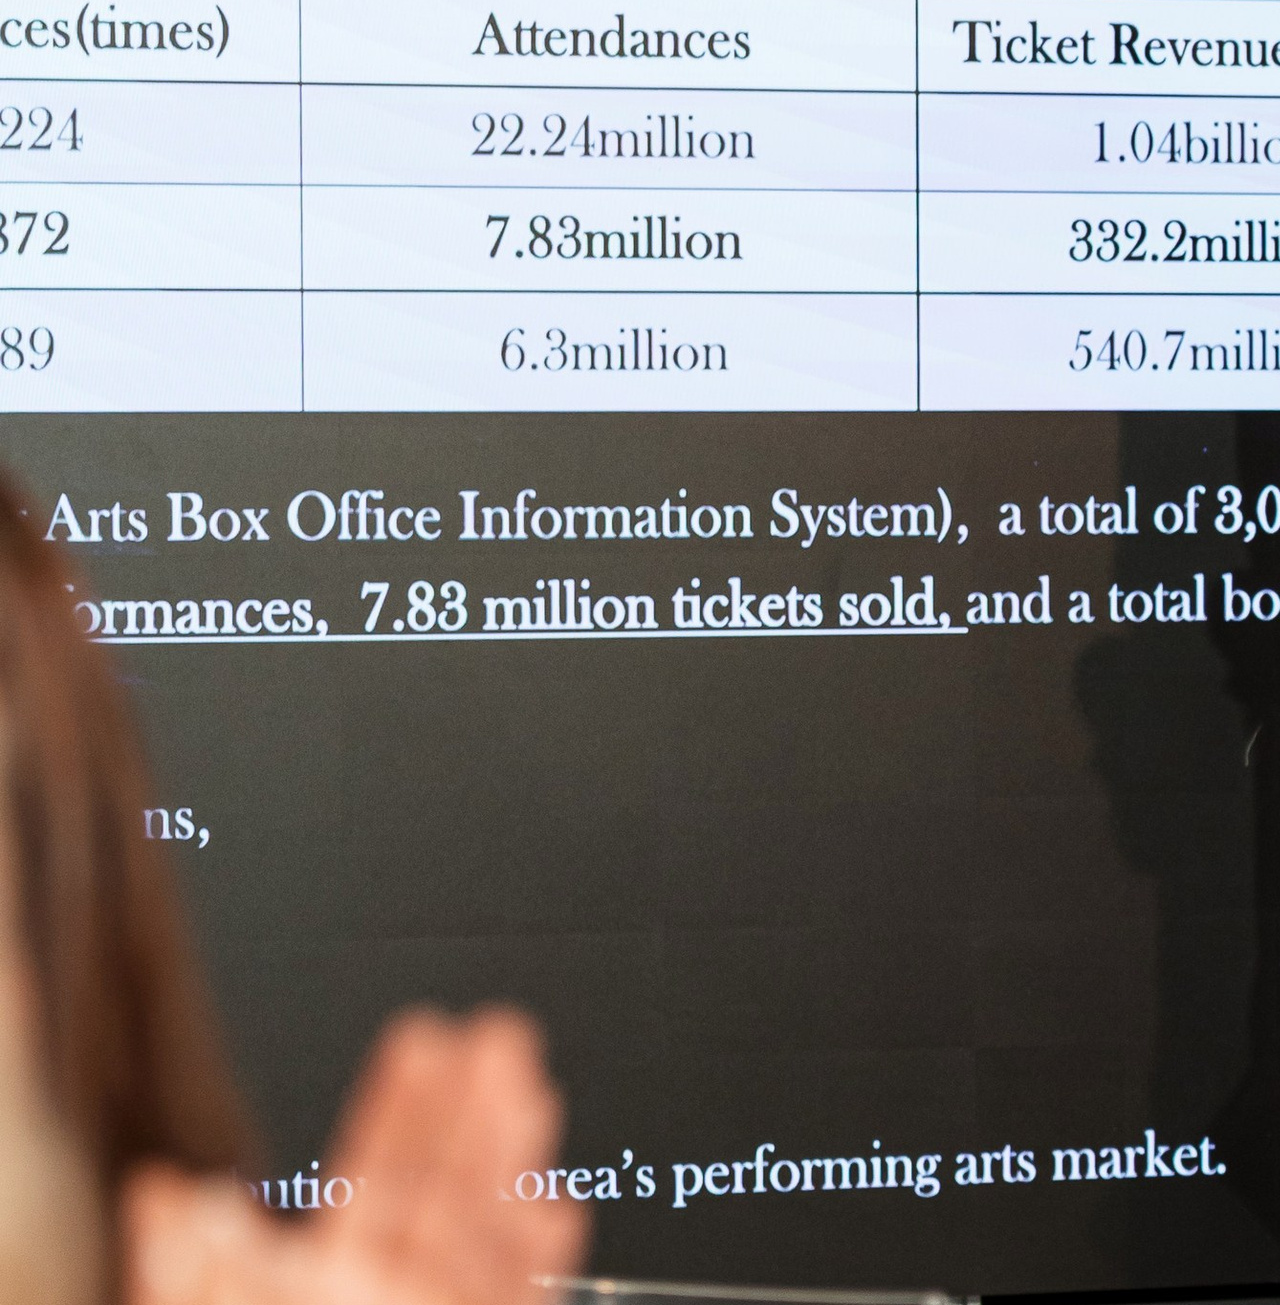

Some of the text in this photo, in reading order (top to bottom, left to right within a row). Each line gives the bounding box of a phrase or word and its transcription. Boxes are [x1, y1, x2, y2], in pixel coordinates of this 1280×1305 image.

[0, 3, 229, 58] ces(times)
[472, 13, 750, 59] Attendances
[953, 21, 1096, 64] Ticket
[0, 106, 84, 152] 224
[473, 114, 753, 158] 22.24million
[487, 215, 742, 259] 7.83million
[0, 328, 54, 370] 89
[501, 329, 726, 370] 6.3million
[45, 493, 147, 542] Arts
[167, 493, 269, 541] Box
[287, 490, 441, 541] Office
[459, 489, 753, 539] Information
[770, 487, 968, 548] System),
[999, 504, 1025, 535] a
[1039, 486, 1138, 534] total
[1154, 485, 1206, 534] of
[66, 583, 329, 637] ormances,
[360, 580, 468, 633] 7.83
[482, 579, 656, 632] million
[672, 577, 824, 630] tickets
[838, 575, 952, 630] sold,
[966, 574, 1054, 626] and
[1069, 591, 1095, 623] a
[1108, 573, 1207, 622] total
[498, 1148, 657, 1202] orea's
[672, 1140, 941, 1208] performing
[955, 1145, 1036, 1185] arts
[1053, 1129, 1226, 1180] market.
